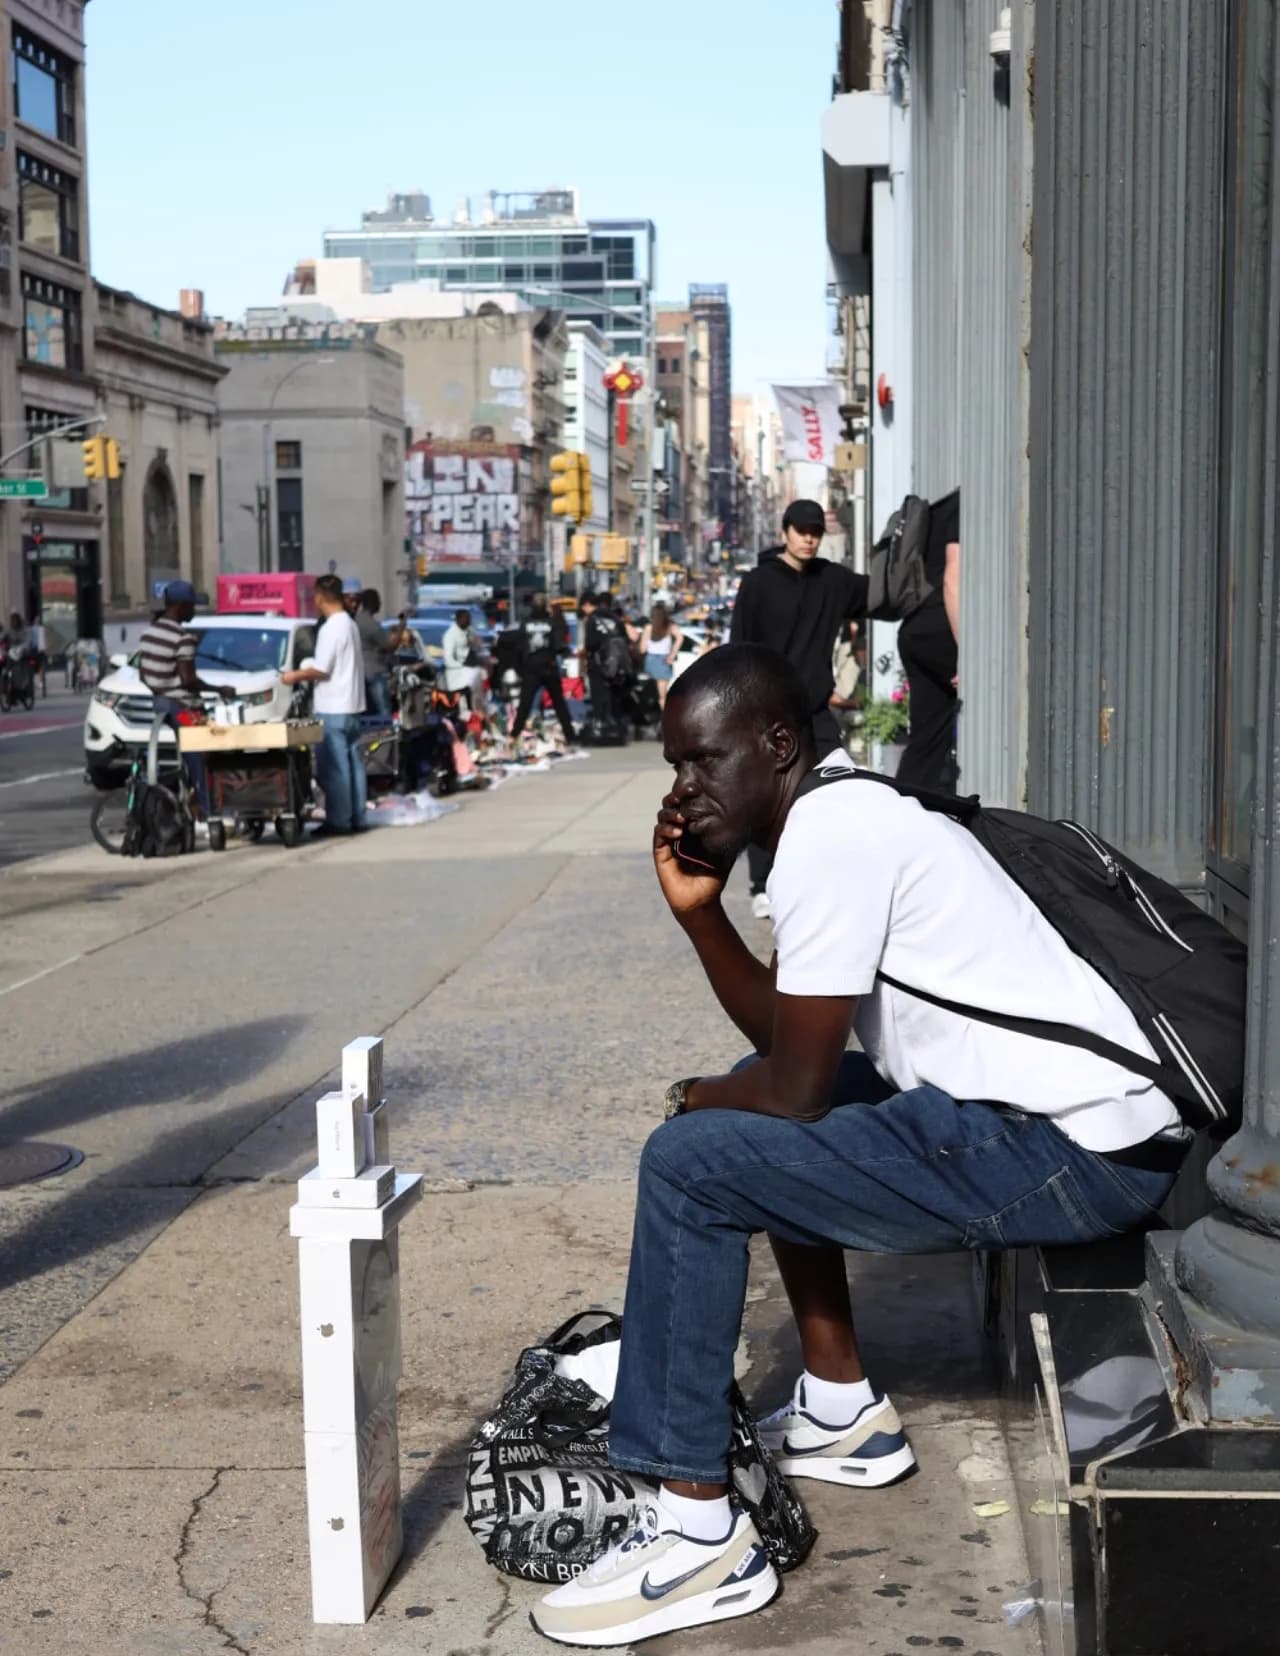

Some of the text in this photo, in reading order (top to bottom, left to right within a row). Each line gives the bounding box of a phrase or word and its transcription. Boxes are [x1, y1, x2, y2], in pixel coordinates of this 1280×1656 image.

[801, 404, 823, 461] SALLY
[469, 1450, 498, 1544] NEW
[508, 1470, 636, 1516] NEW
[490, 1513, 630, 1558] YOR
